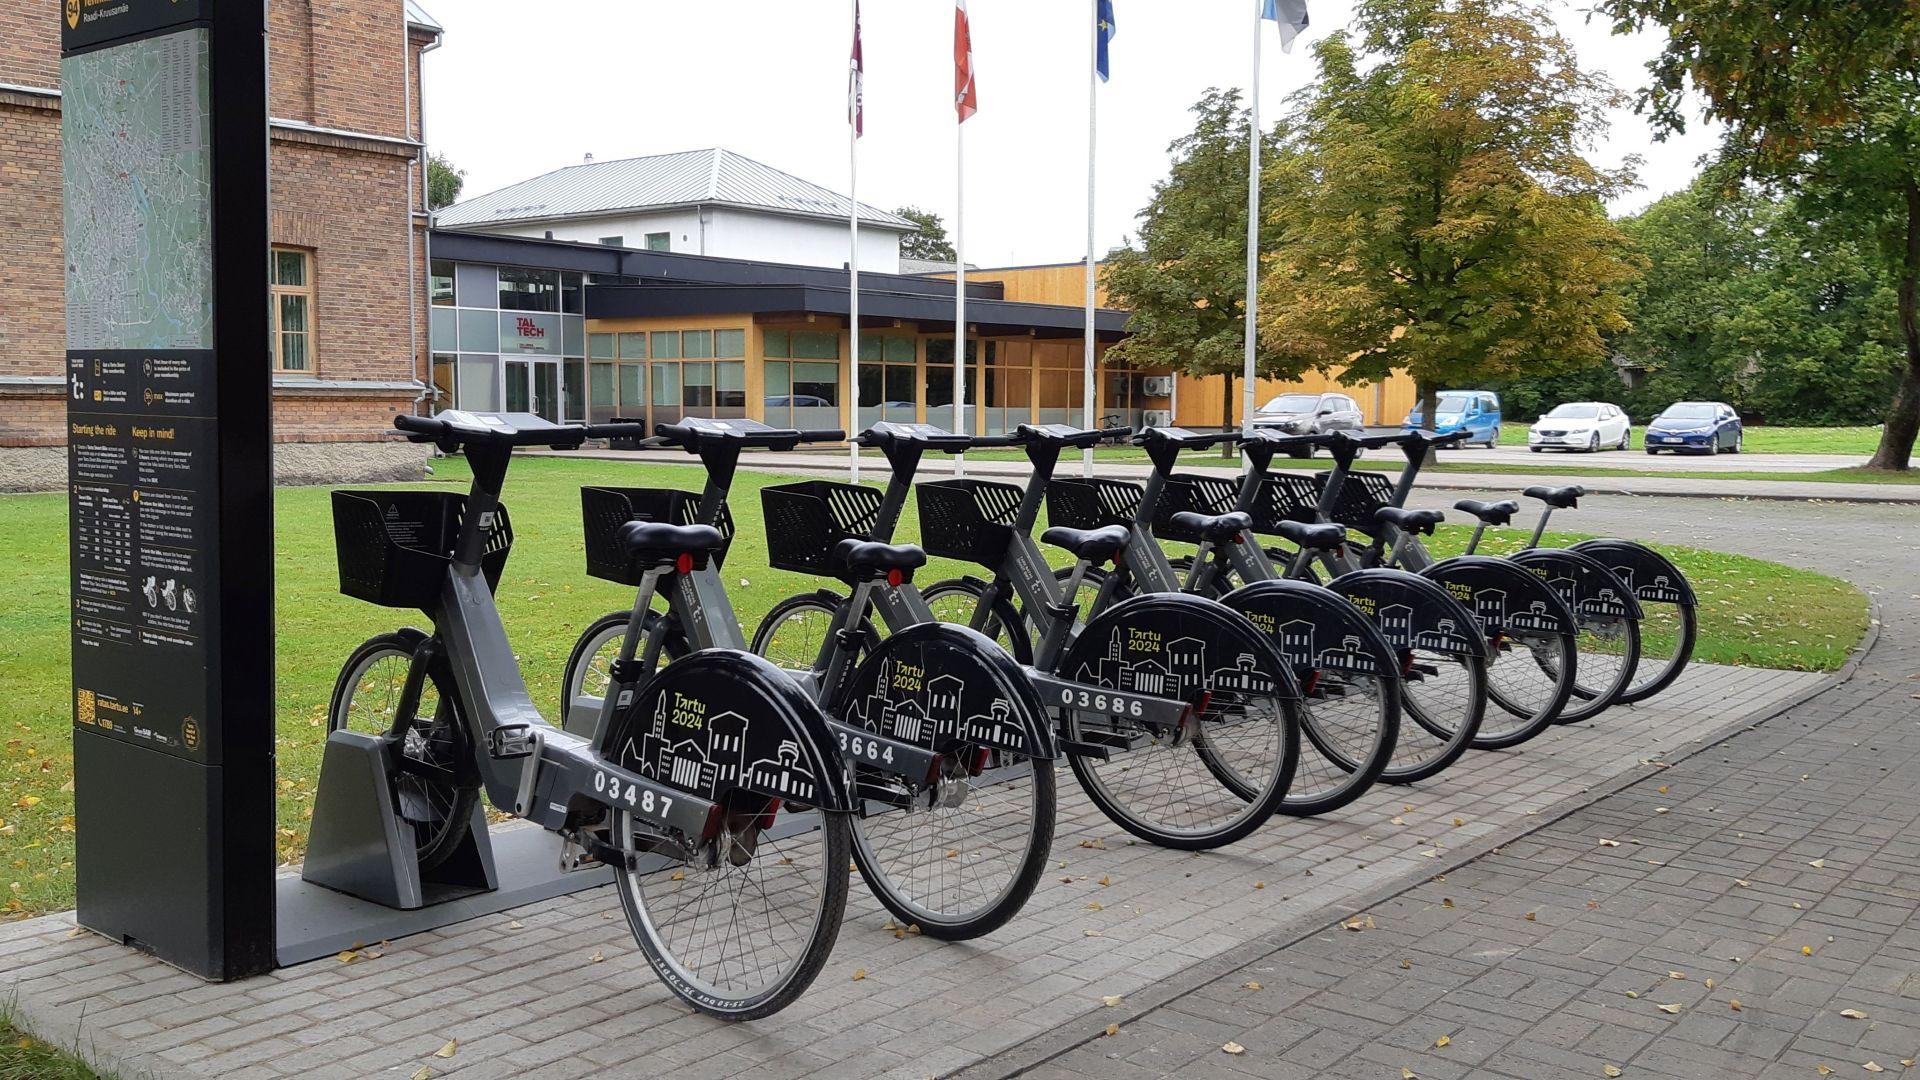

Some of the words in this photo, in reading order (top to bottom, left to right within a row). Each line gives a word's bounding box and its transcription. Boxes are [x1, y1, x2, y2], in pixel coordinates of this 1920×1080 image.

[67, 1, 78, 18] 94
[516, 317, 535, 327] TAL
[517, 326, 544, 337] TECH
[72, 423, 94, 437] Starting
[95, 424, 104, 435] the
[105, 424, 117, 436] ride
[132, 426, 148, 440] Keep
[148, 427, 155, 438] in
[1444, 580, 1472, 592] Tartu
[1347, 594, 1376, 607] Tartu
[1244, 610, 1275, 624] Tartu
[1128, 628, 1161, 642] Tartu
[1128, 640, 1161, 653] 2024
[895, 660, 924, 678] Tartu
[893, 674, 922, 692] 2024
[674, 692, 706, 714] Tartu
[1061, 688, 1143, 717] 03686
[671, 709, 703, 731] 2024
[594, 769, 673, 819] 03487
